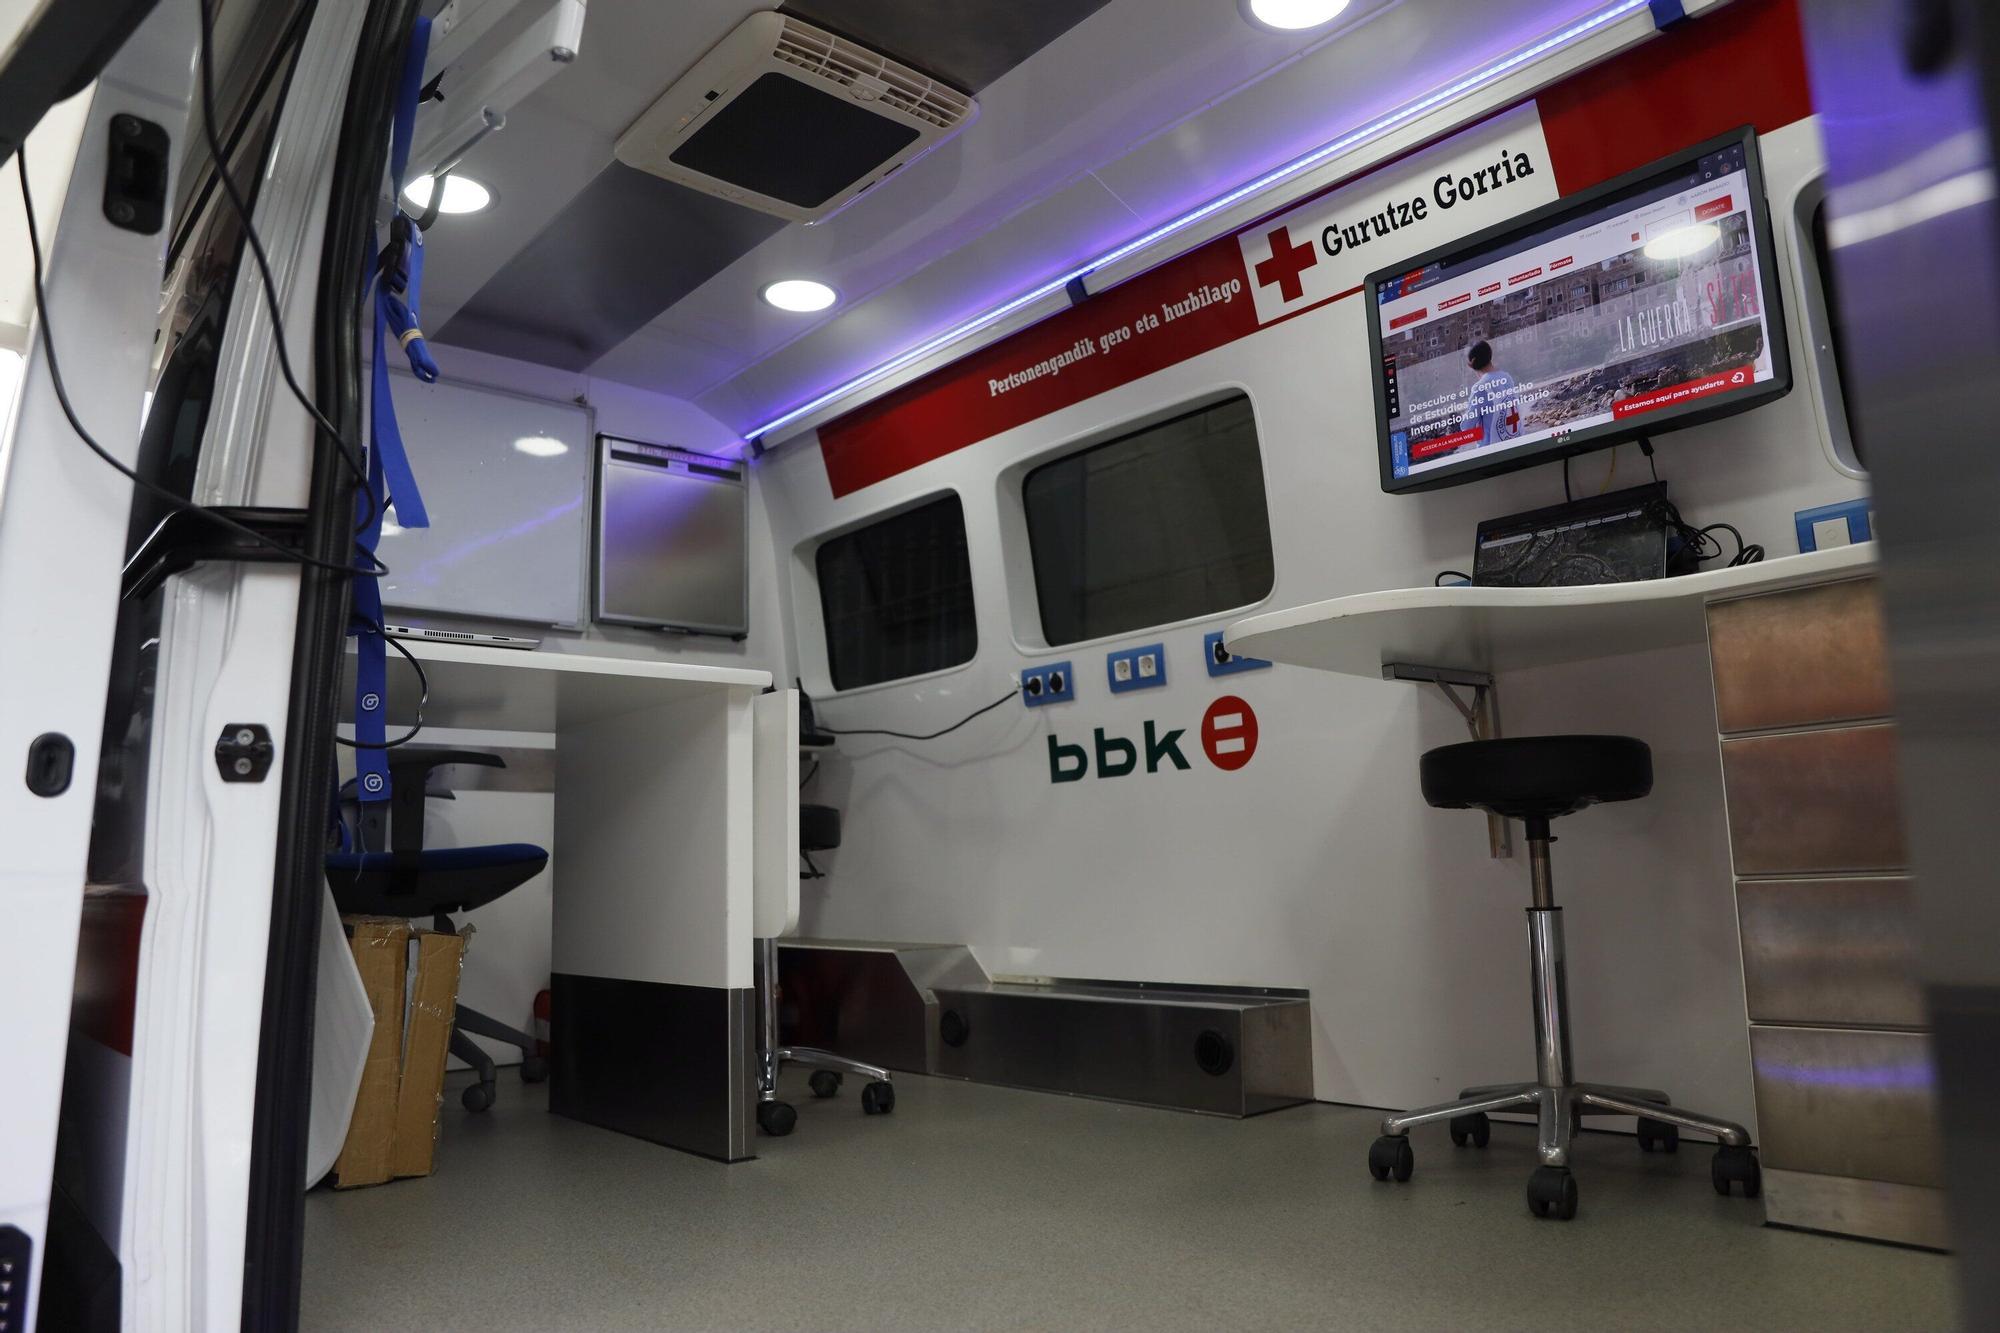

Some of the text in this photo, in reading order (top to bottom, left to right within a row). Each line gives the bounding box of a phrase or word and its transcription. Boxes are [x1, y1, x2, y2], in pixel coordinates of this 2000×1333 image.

[1321, 149, 1535, 257] Gurutze Gorria
[987, 277, 1241, 397] Pertsonengandik gero eta hurbilago
[1618, 315, 1636, 353] LA
[1638, 296, 1693, 347] GUERRA
[1409, 376, 1508, 414] Descubre el Centro
[1409, 380, 1534, 425] de Estudios de Derecho
[1410, 387, 1550, 438] Internacional Humanitario
[1624, 398, 1655, 411] Estamos
[1655, 393, 1672, 405] aquí
[1673, 389, 1690, 400] para
[1691, 379, 1725, 395] ayudarte
[1047, 719, 1192, 784] bbk
